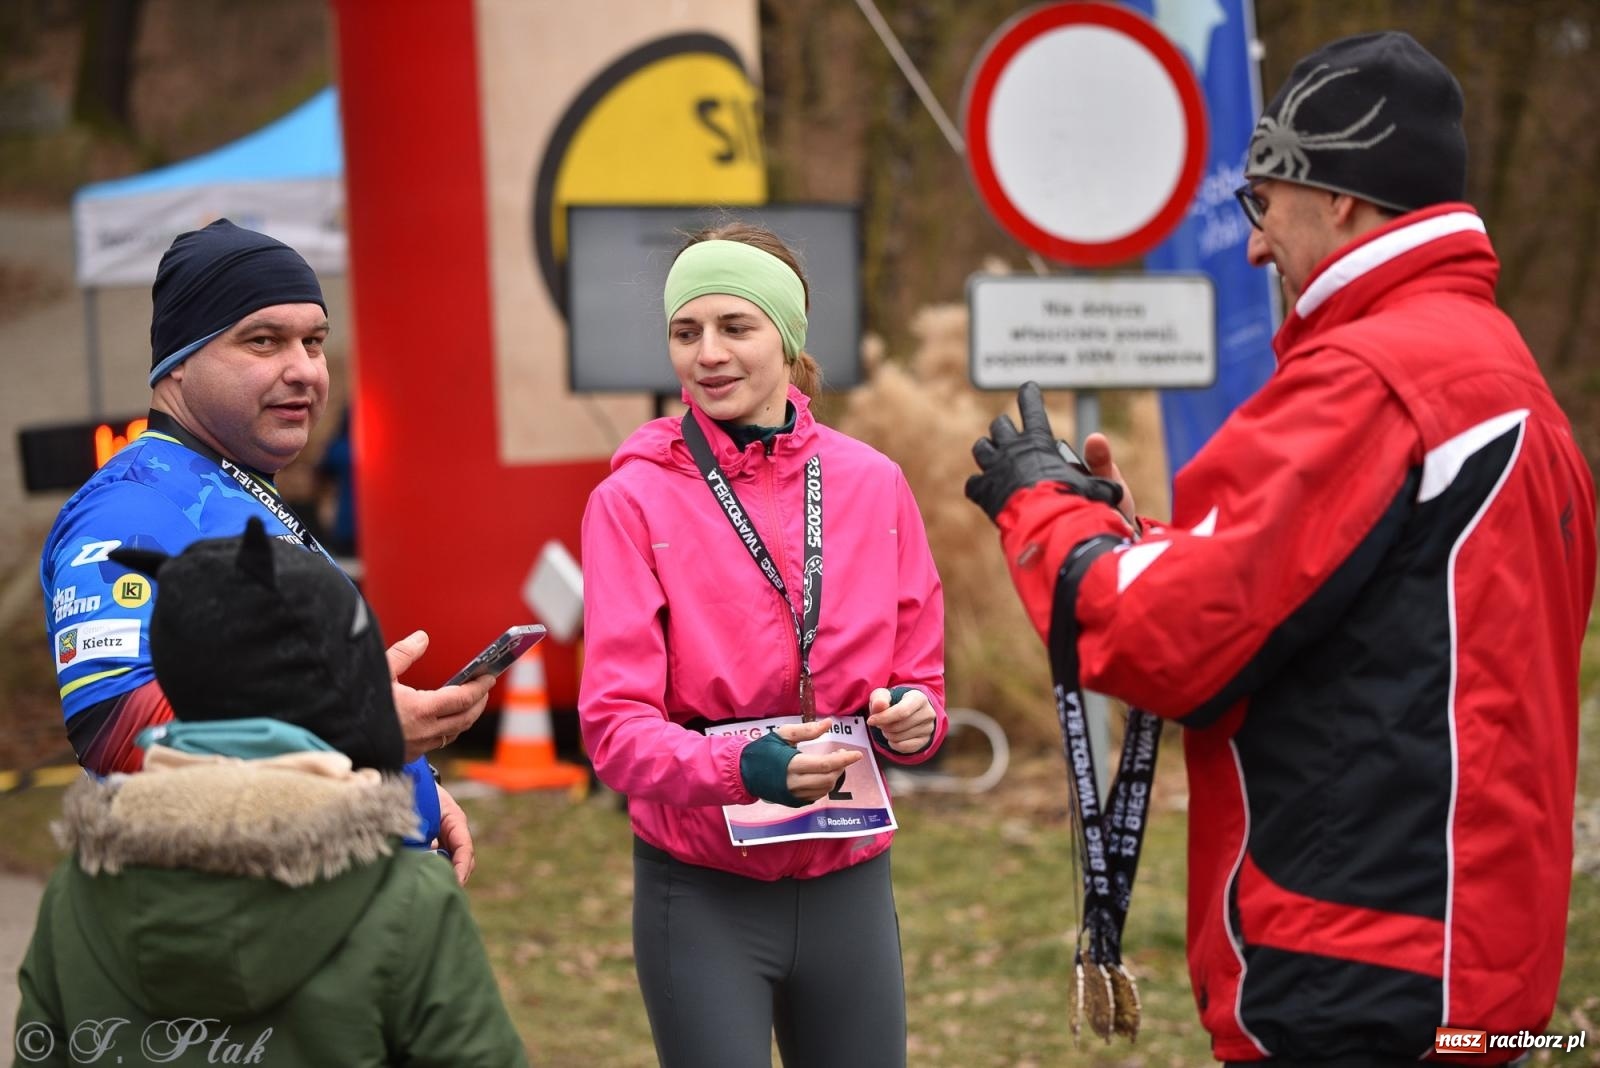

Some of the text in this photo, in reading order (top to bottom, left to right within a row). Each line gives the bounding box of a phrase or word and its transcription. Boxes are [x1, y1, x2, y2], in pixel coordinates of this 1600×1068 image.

[221, 458, 306, 541] TWARDZIELA
[707, 467, 784, 592] BIEG TWARDZIELA
[806, 455, 822, 548] 23.02.2025
[82, 638, 123, 650] Kietrz
[1121, 834, 1138, 857] 13
